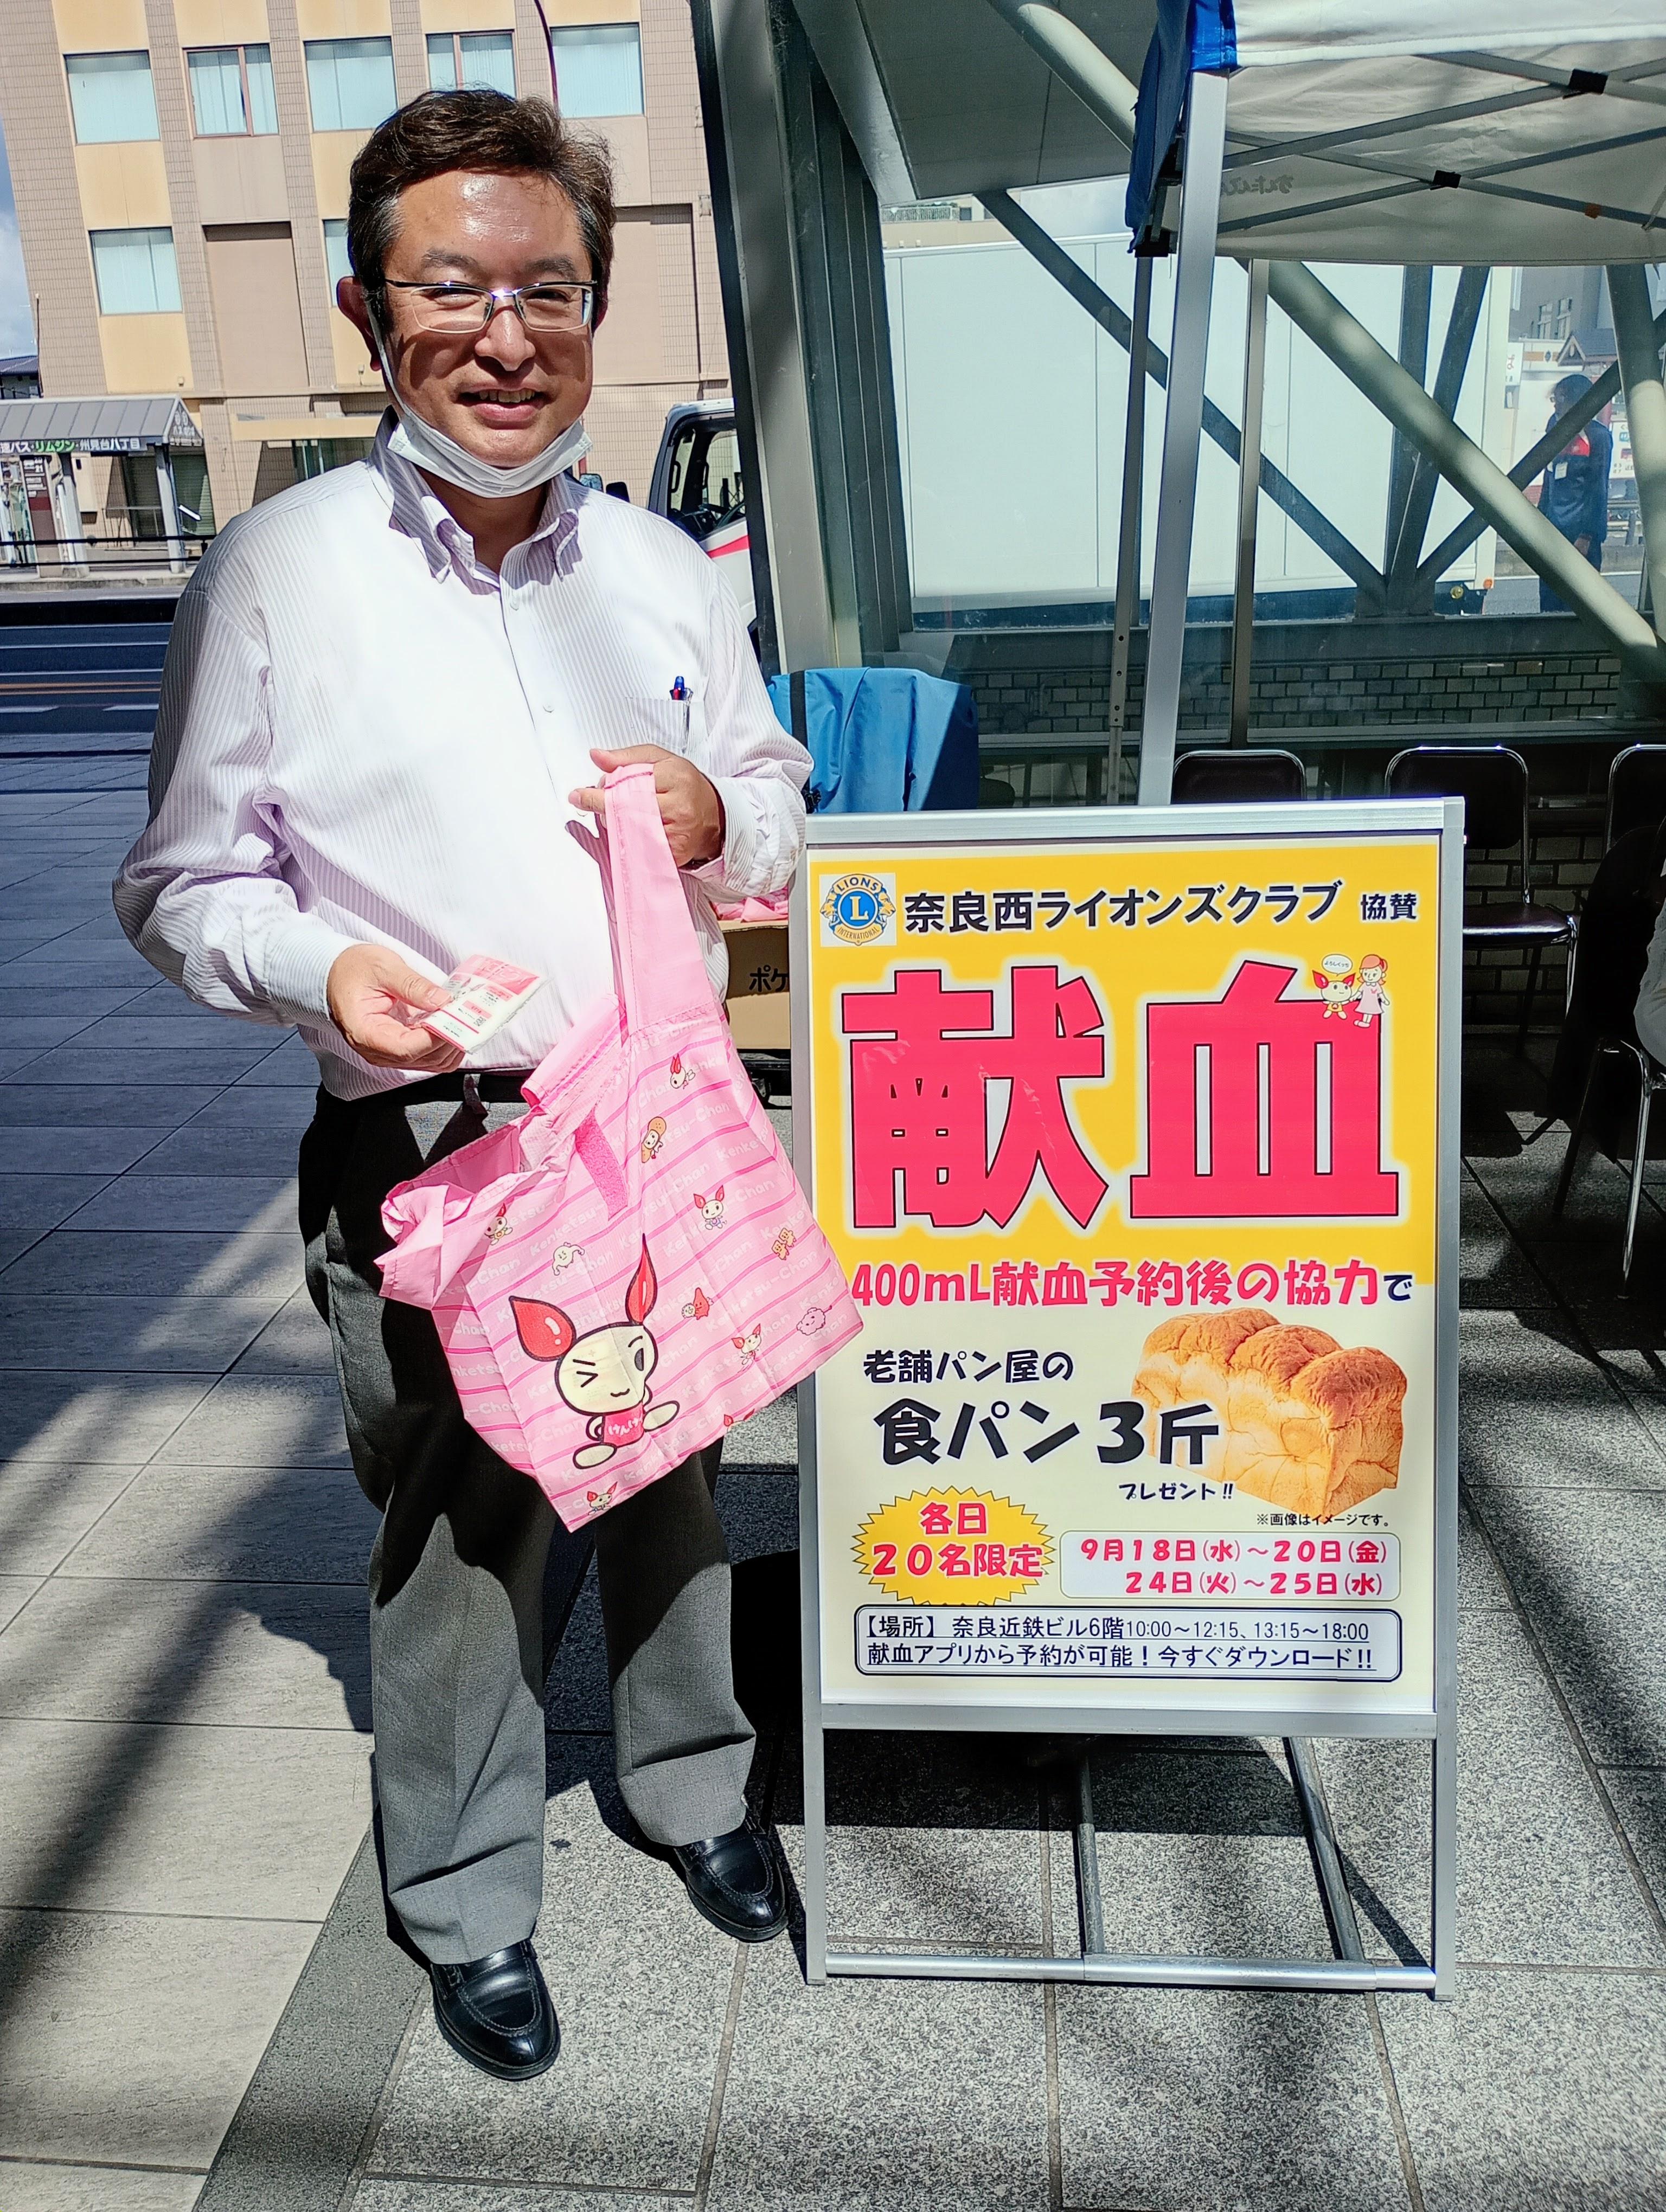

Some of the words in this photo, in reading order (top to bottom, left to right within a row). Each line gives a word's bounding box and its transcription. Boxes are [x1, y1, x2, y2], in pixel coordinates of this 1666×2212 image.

[837, 877, 879, 892] LIONS
[849, 895, 868, 921] L
[905, 880, 1343, 933] 奈良西ライオンズクラブ
[1361, 893, 1417, 921] 協賛
[837, 926, 880, 941] INTERNATIONAL
[842, 961, 1399, 1228] 献血
[863, 1349, 1073, 1384] 老舗パン屋の
[921, 1502, 987, 1535] 各日
[873, 1542, 1043, 1578] 20名限定
